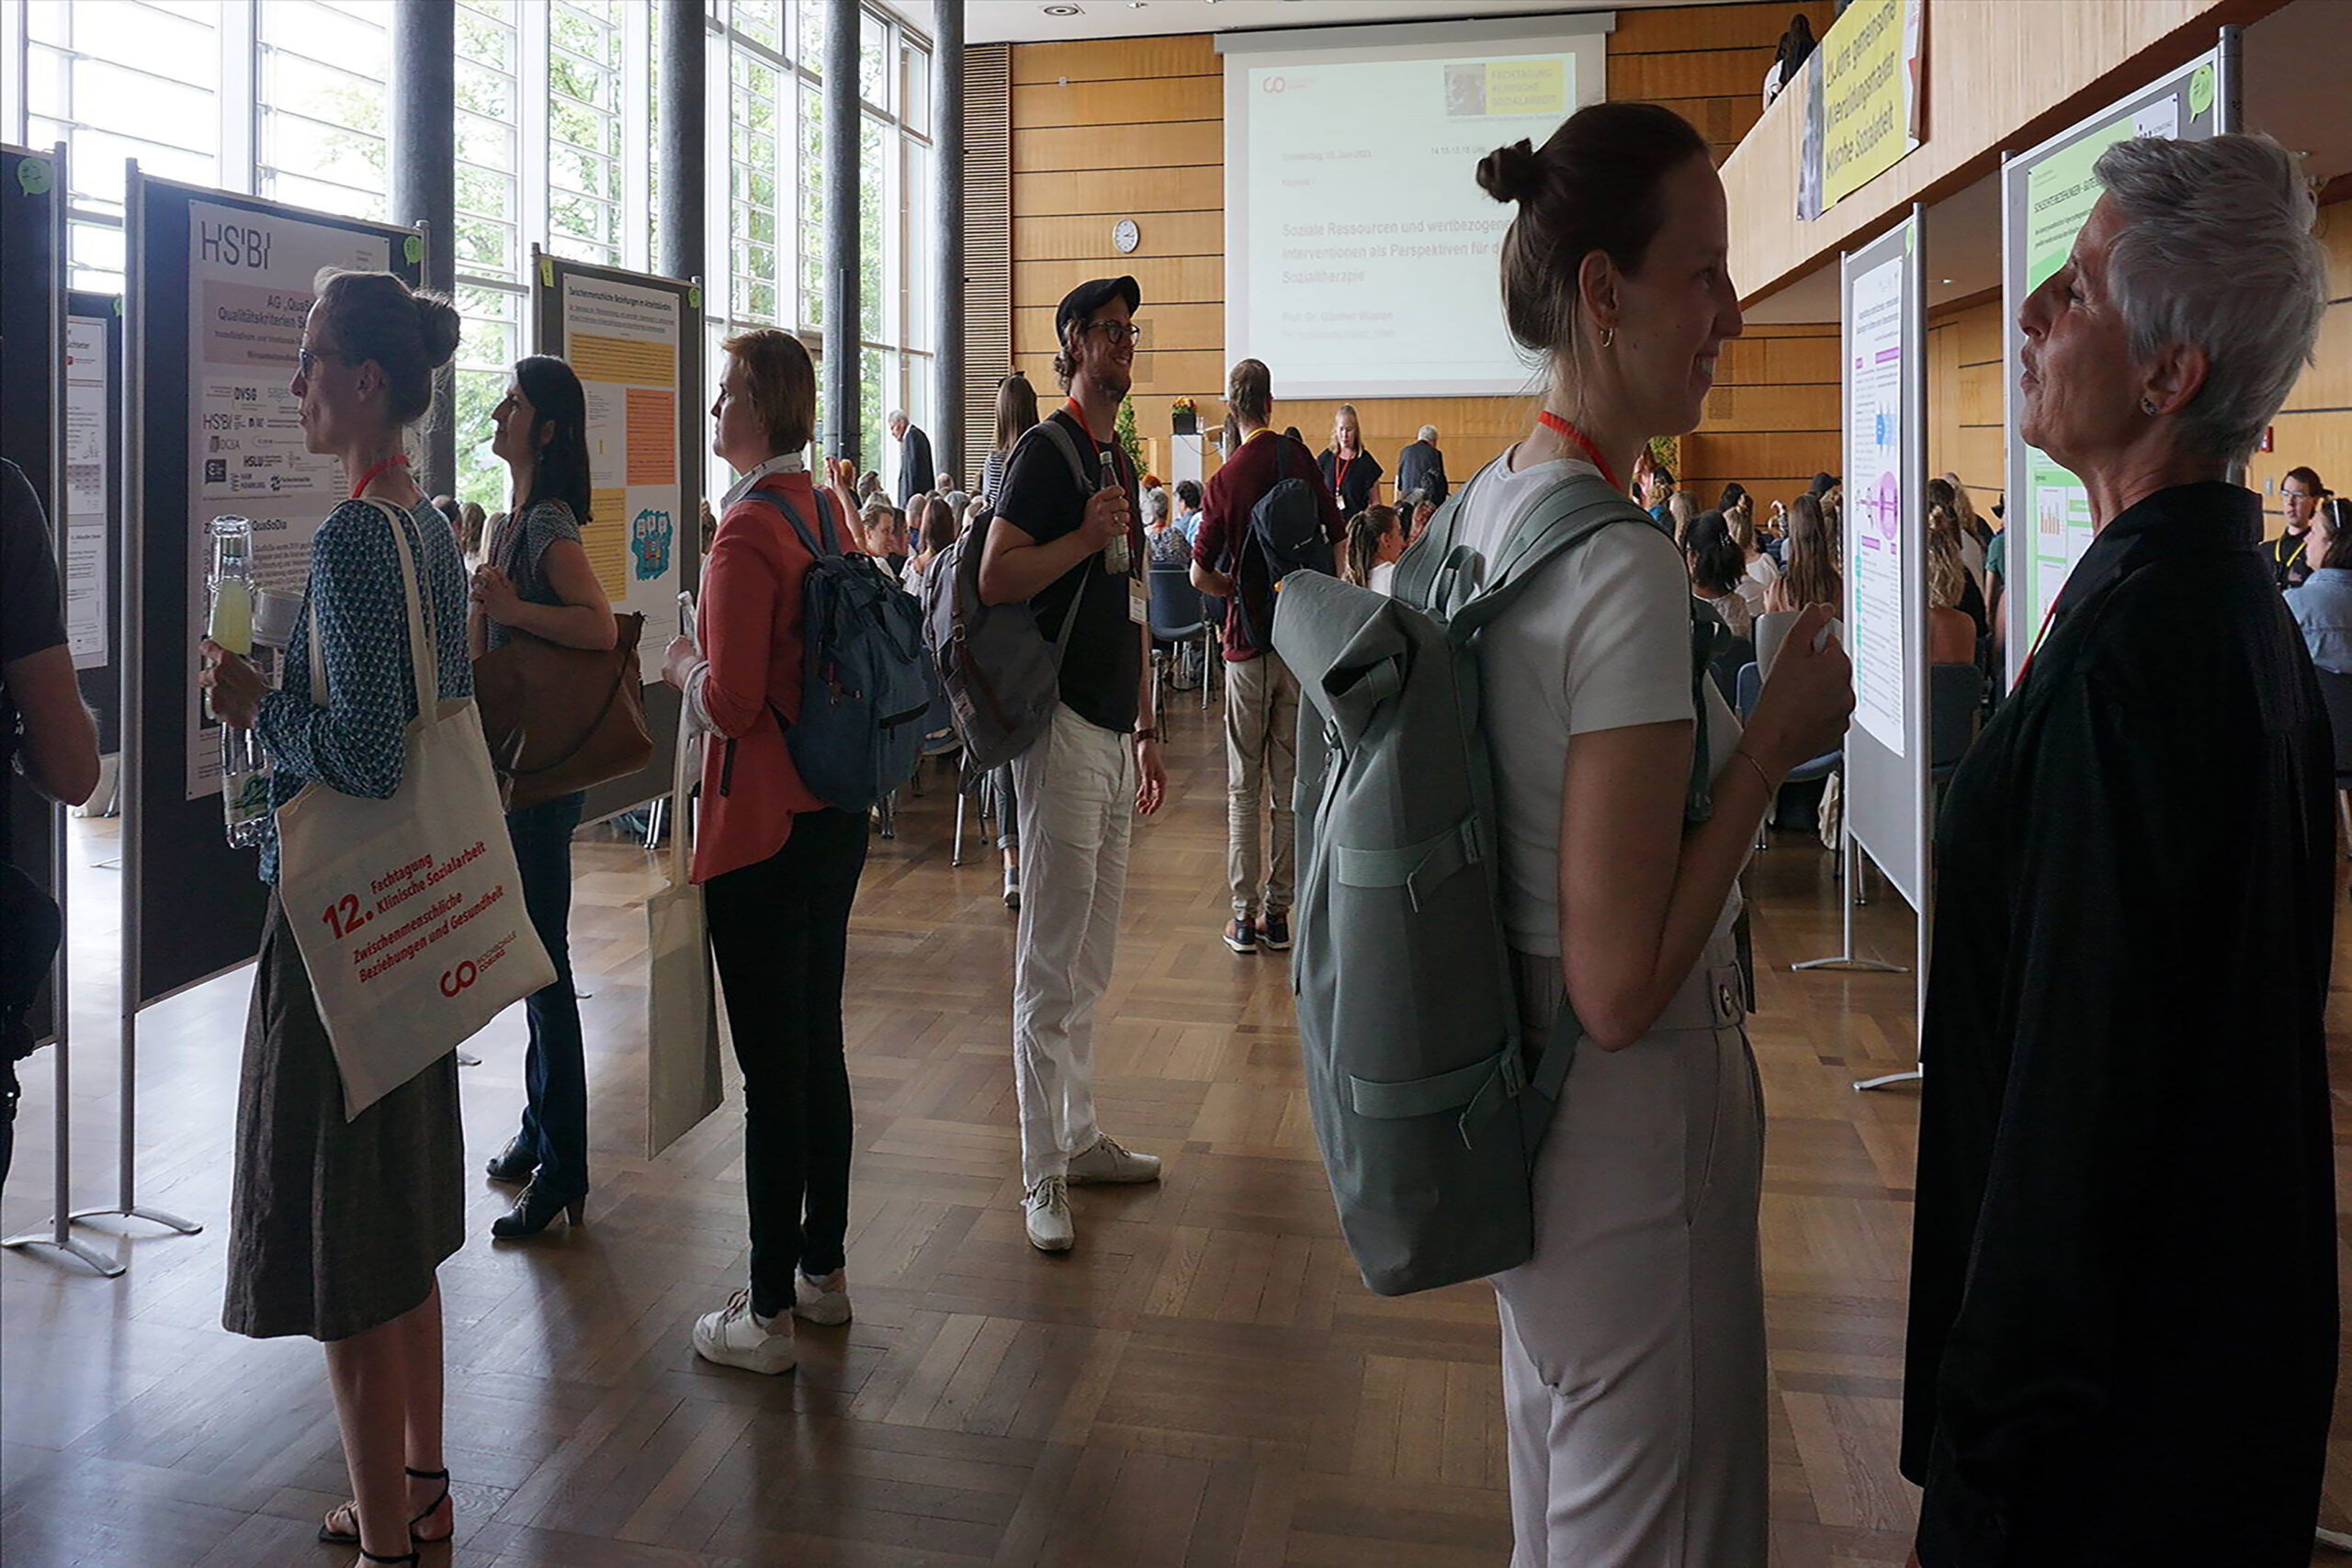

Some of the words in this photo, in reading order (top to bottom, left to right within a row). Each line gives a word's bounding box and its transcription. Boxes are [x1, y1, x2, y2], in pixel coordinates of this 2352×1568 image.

[1283, 223, 1324, 237] Soziale
[1327, 221, 1399, 236] Ressourcen
[1401, 222, 1424, 233] und
[1283, 246, 1367, 260] Interventionen
[1370, 244, 1387, 257] als
[1390, 243, 1468, 259] Perspektiven
[1471, 241, 1488, 254] für
[266, 295, 281, 309] AG
[371, 852, 434, 895] Fachtagung
[377, 880, 426, 915] Klinische
[427, 840, 488, 888] Sozialarbeit
[322, 893, 375, 941] 12.
[353, 891, 464, 964] Zwischenmenschliche
[358, 934, 427, 984] Beziehungen
[429, 922, 450, 944] und
[450, 885, 504, 931] Gesundheit
[440, 960, 477, 998] CO
